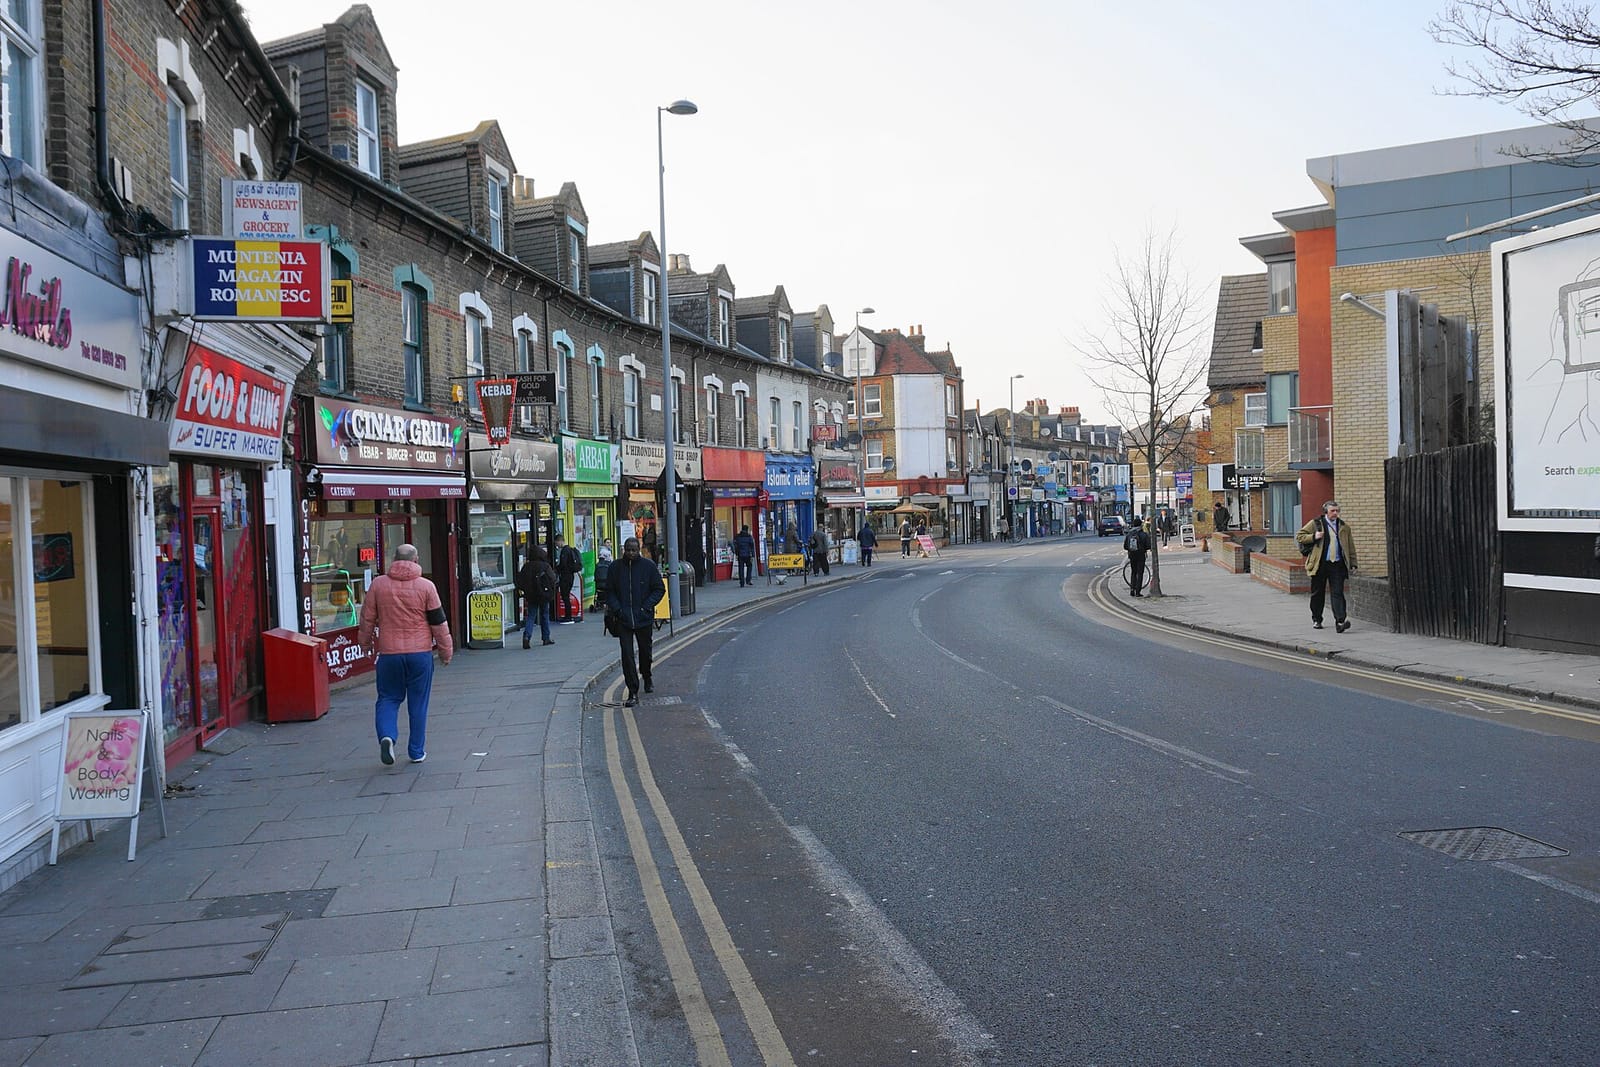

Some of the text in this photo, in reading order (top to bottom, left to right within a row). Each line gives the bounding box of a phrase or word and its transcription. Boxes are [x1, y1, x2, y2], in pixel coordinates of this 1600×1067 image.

[235, 198, 298, 211] NEWSAGENT
[262, 211, 269, 221] &
[243, 221, 290, 233] GROCERY
[207, 250, 307, 265] MUNTENIA
[217, 269, 303, 284] MAGAZIN
[210, 287, 311, 303] ROMANESC
[0, 256, 72, 350] Nails
[481, 384, 512, 397] KEBAB
[184, 364, 281, 431] FOOD & WINE
[409, 418, 453, 447] GRILL
[490, 427, 507, 438] OPEN
[194, 428, 237, 451] SUPER
[242, 435, 279, 456] MARKET
[416, 450, 437, 463] CHICKEN
[579, 445, 608, 471] ARBAT
[686, 451, 698, 461] SHOP
[1544, 465, 1575, 476] Search
[767, 469, 791, 487] islamic
[794, 469, 811, 486] relief
[330, 486, 356, 496] CATERING
[360, 548, 375, 562] OPEN
[474, 614, 499, 622] SILVER
[86, 728, 124, 741] Nails
[97, 748, 110, 760] &
[78, 766, 120, 782] Body
[69, 786, 130, 801] Waxing
